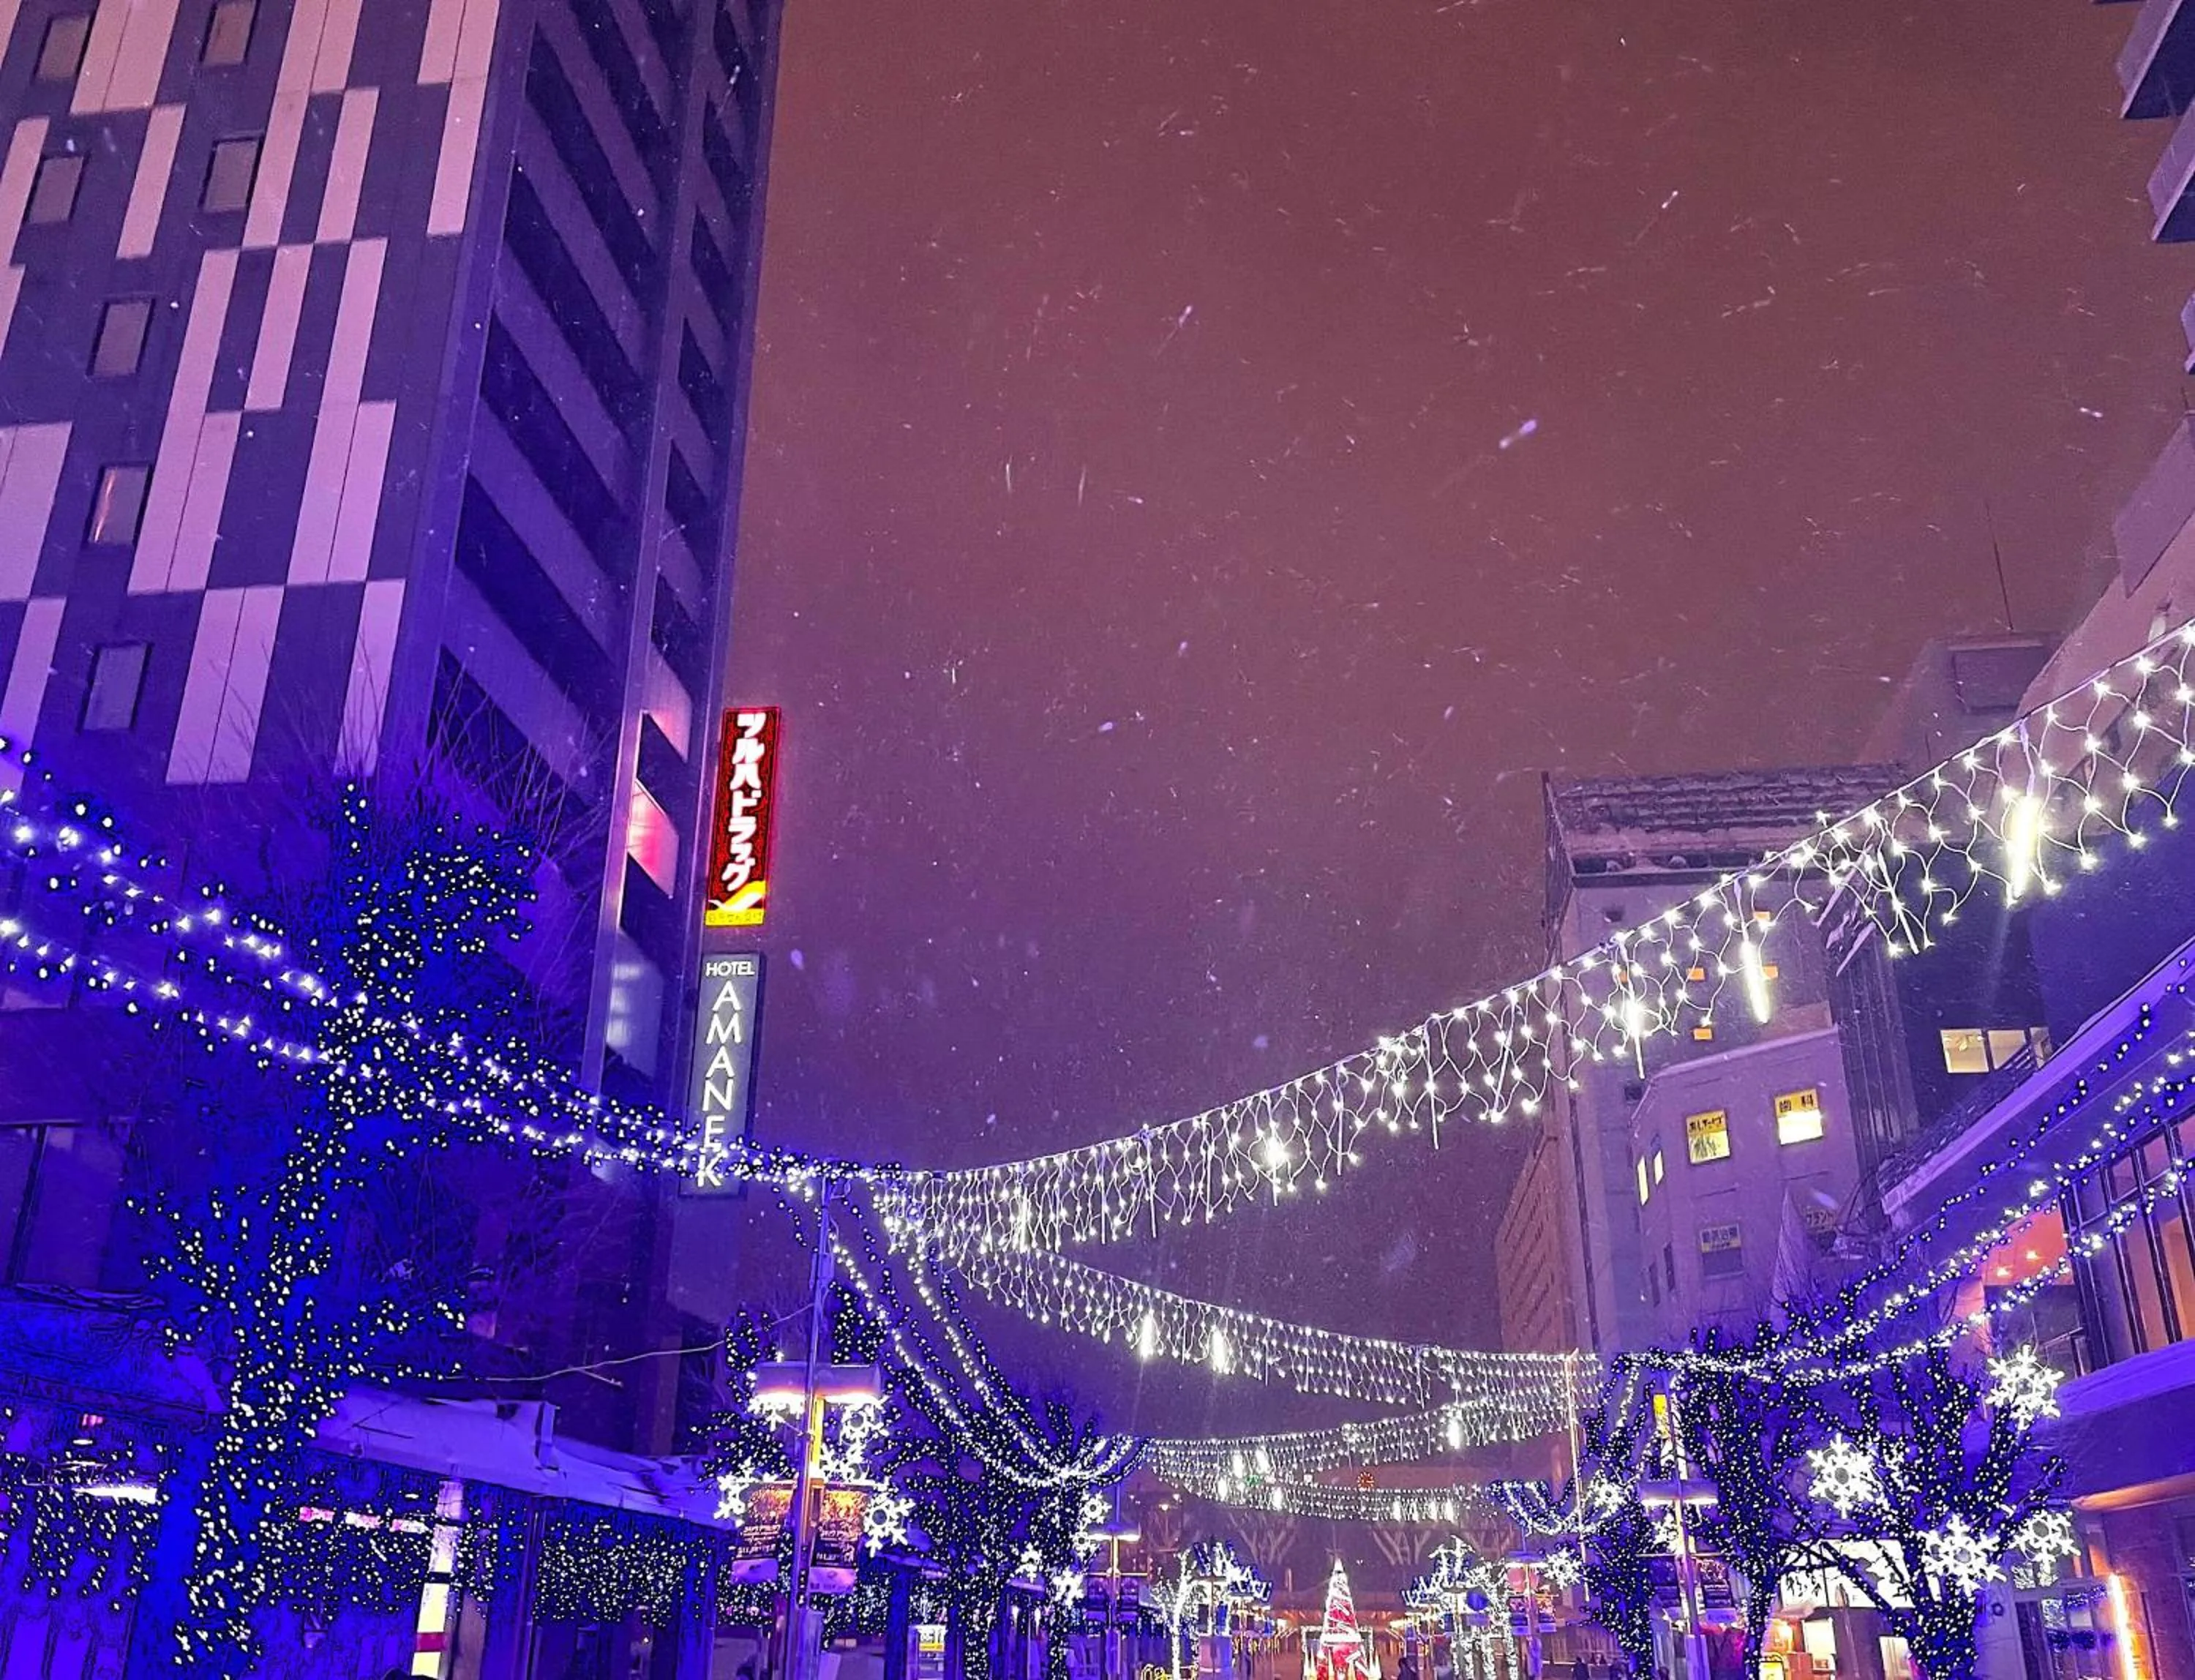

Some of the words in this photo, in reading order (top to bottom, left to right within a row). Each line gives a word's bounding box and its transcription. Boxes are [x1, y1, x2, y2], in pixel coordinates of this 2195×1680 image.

[721, 712, 767, 892] ツルハドラッグ
[705, 961, 756, 978] HOTEL
[697, 980, 743, 1188] AMANEK
